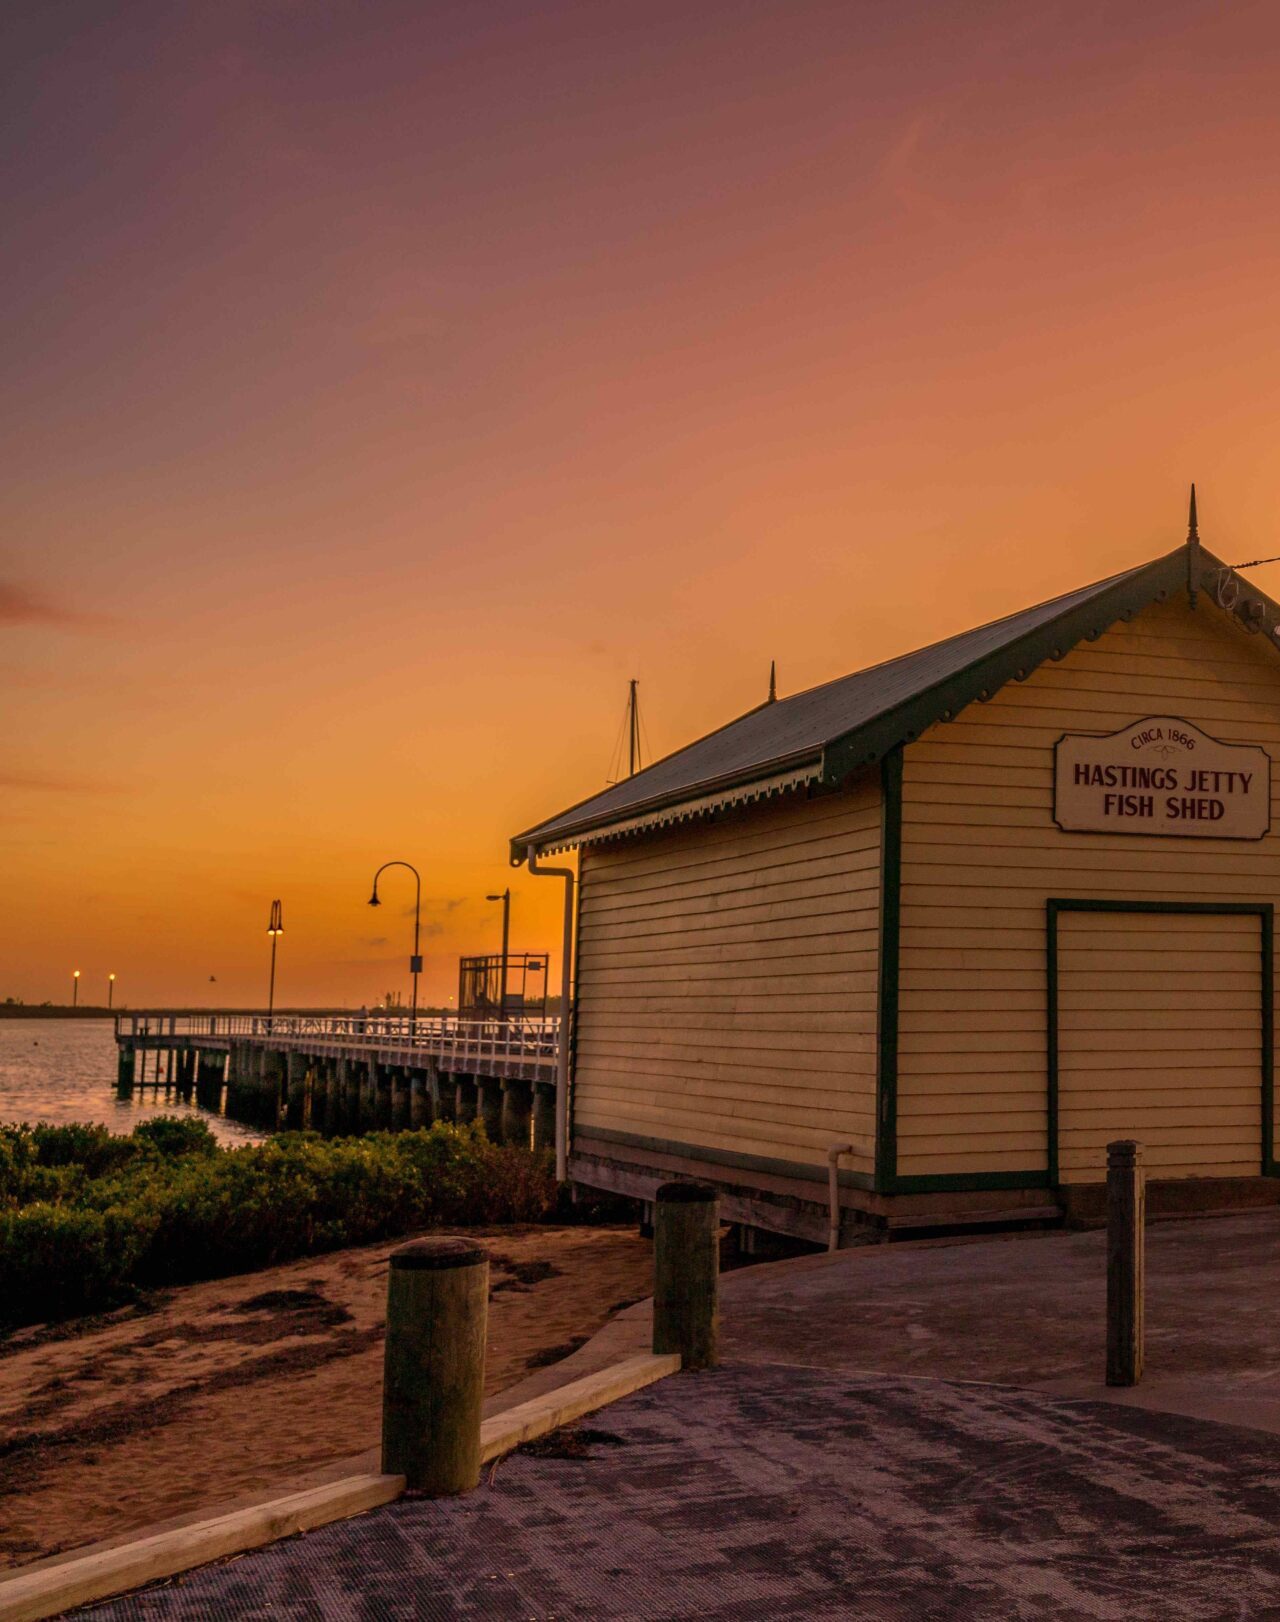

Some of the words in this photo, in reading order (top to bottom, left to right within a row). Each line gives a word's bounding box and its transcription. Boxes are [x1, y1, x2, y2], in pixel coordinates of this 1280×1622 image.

[1131, 728, 1163, 750] CIRCA
[1168, 729, 1196, 750] 1866
[1074, 763, 1178, 790] HASTINGS
[1184, 770, 1253, 794] JETTY
[1104, 794, 1154, 817] FISH
[1166, 797, 1225, 820] SHED
